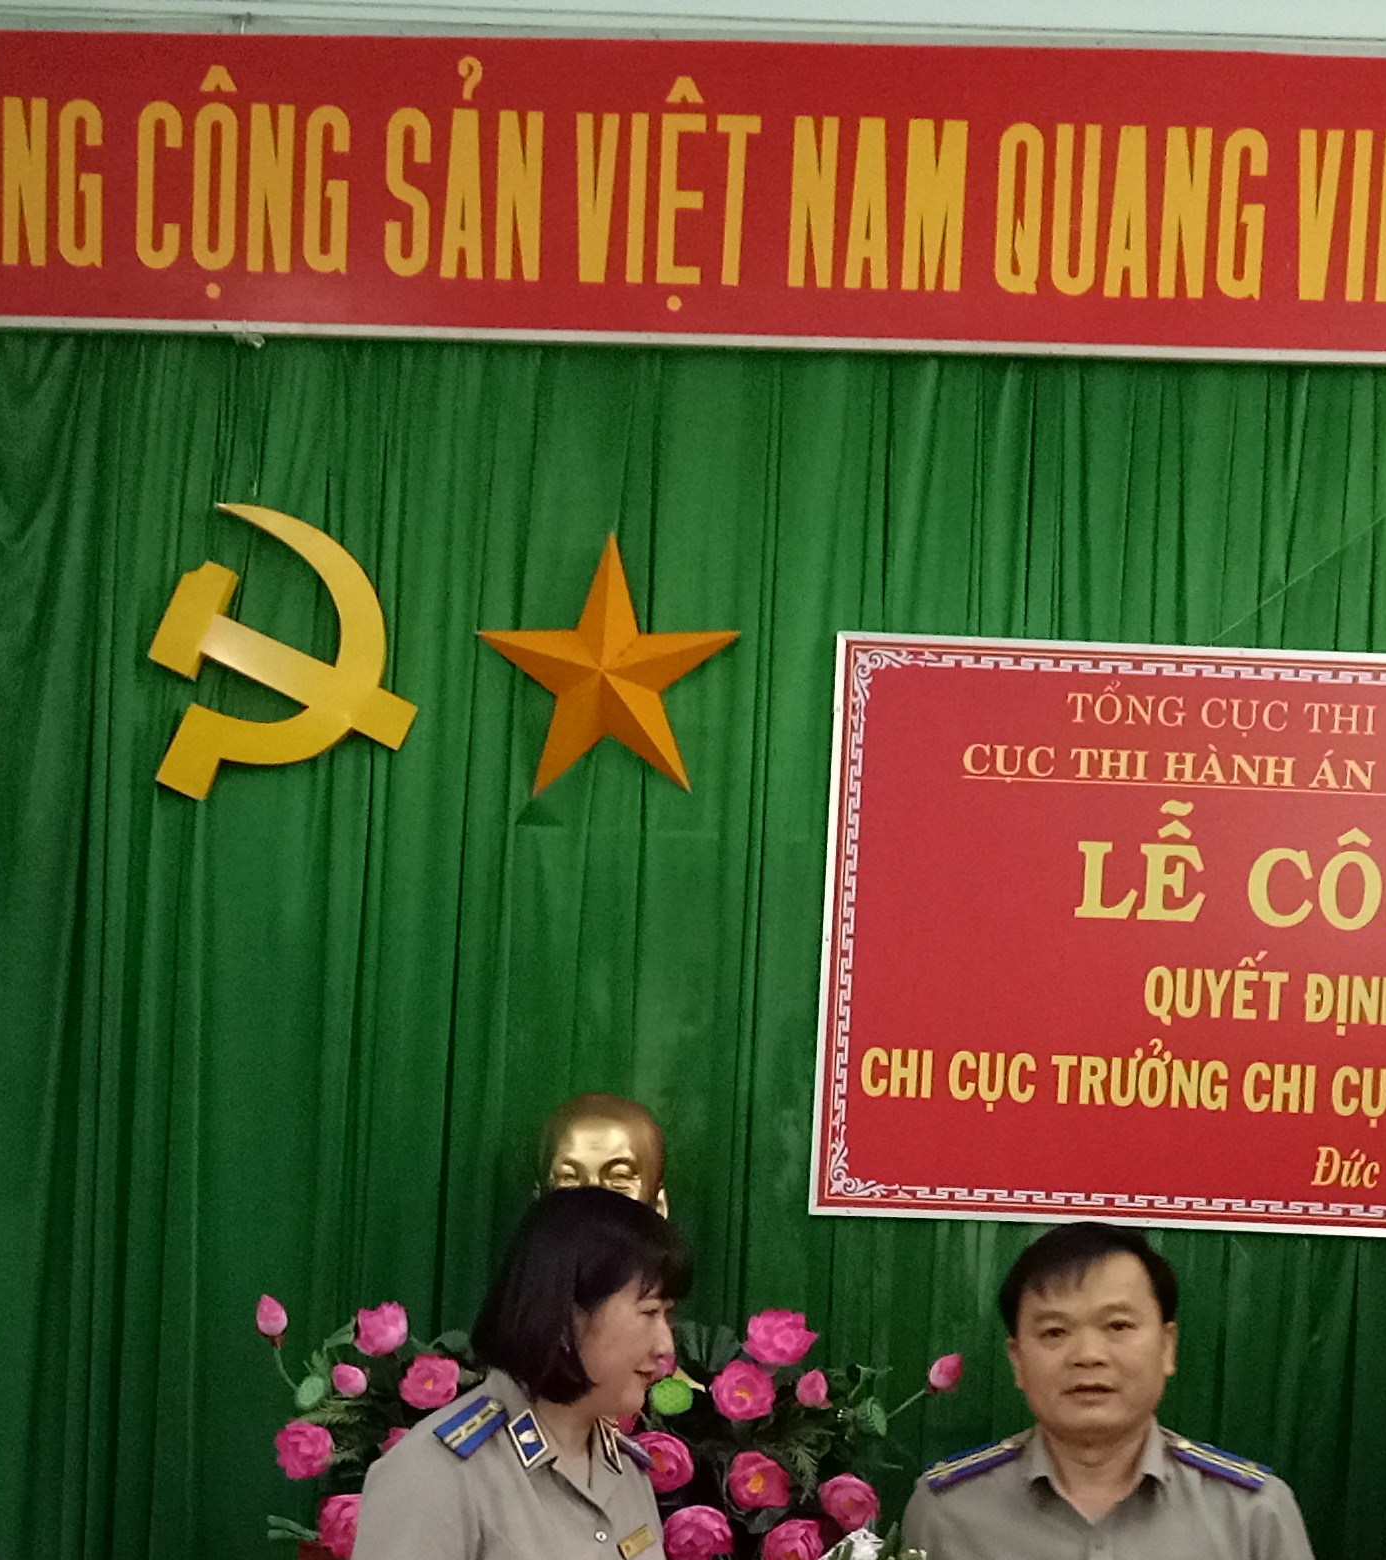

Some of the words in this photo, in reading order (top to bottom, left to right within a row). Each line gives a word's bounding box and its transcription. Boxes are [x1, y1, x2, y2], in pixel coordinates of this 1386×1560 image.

[136, 64, 349, 300] CỘNG
[385, 56, 543, 282] SẢN
[576, 76, 761, 311] VIỆT
[788, 115, 968, 292] NAM
[994, 122, 1269, 299] QUANG
[1067, 681, 1185, 727] TỔNG
[1201, 697, 1289, 738] CỤC
[1303, 702, 1377, 736] THI
[962, 743, 1056, 783] CỤC
[1070, 747, 1149, 781] THI
[1164, 744, 1296, 788] HÀNH
[1309, 750, 1377, 793] ÁN
[1074, 799, 1207, 922] LỄ
[1144, 950, 1289, 1025] QUYẾT
[860, 1046, 933, 1099] CHI
[948, 1049, 1037, 1112] CỤC
[1051, 1037, 1228, 1112] TRƯỞNG
[1242, 1062, 1317, 1114] CHI
[1311, 1145, 1380, 1189] Đức
